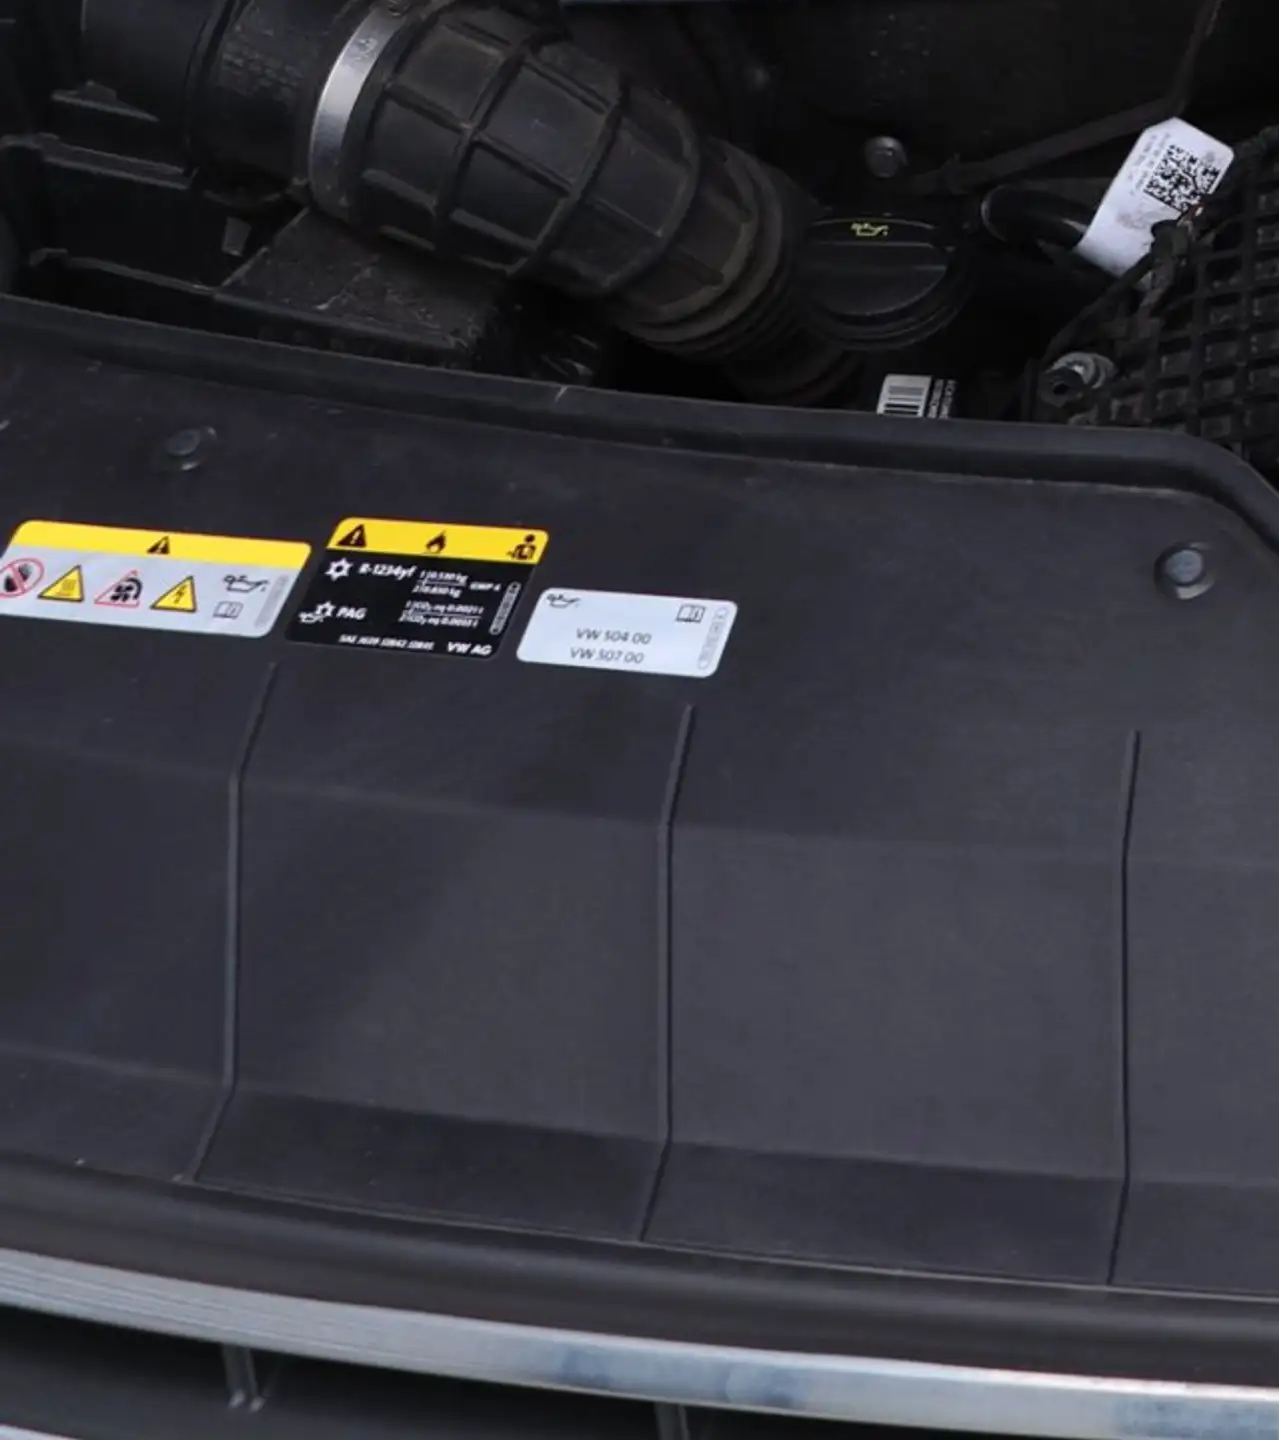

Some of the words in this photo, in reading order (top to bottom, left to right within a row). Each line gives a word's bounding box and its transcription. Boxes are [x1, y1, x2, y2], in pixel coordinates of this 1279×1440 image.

[358, 562, 417, 580] R-1234yf
[336, 605, 368, 620] PAG
[576, 628, 601, 641] VW
[603, 628, 629, 643] 504
[631, 631, 653, 646] 00
[447, 641, 472, 654] VW
[470, 643, 494, 657] AG
[569, 646, 596, 660] VW
[598, 647, 623, 662] 507
[623, 651, 645, 665] 00
